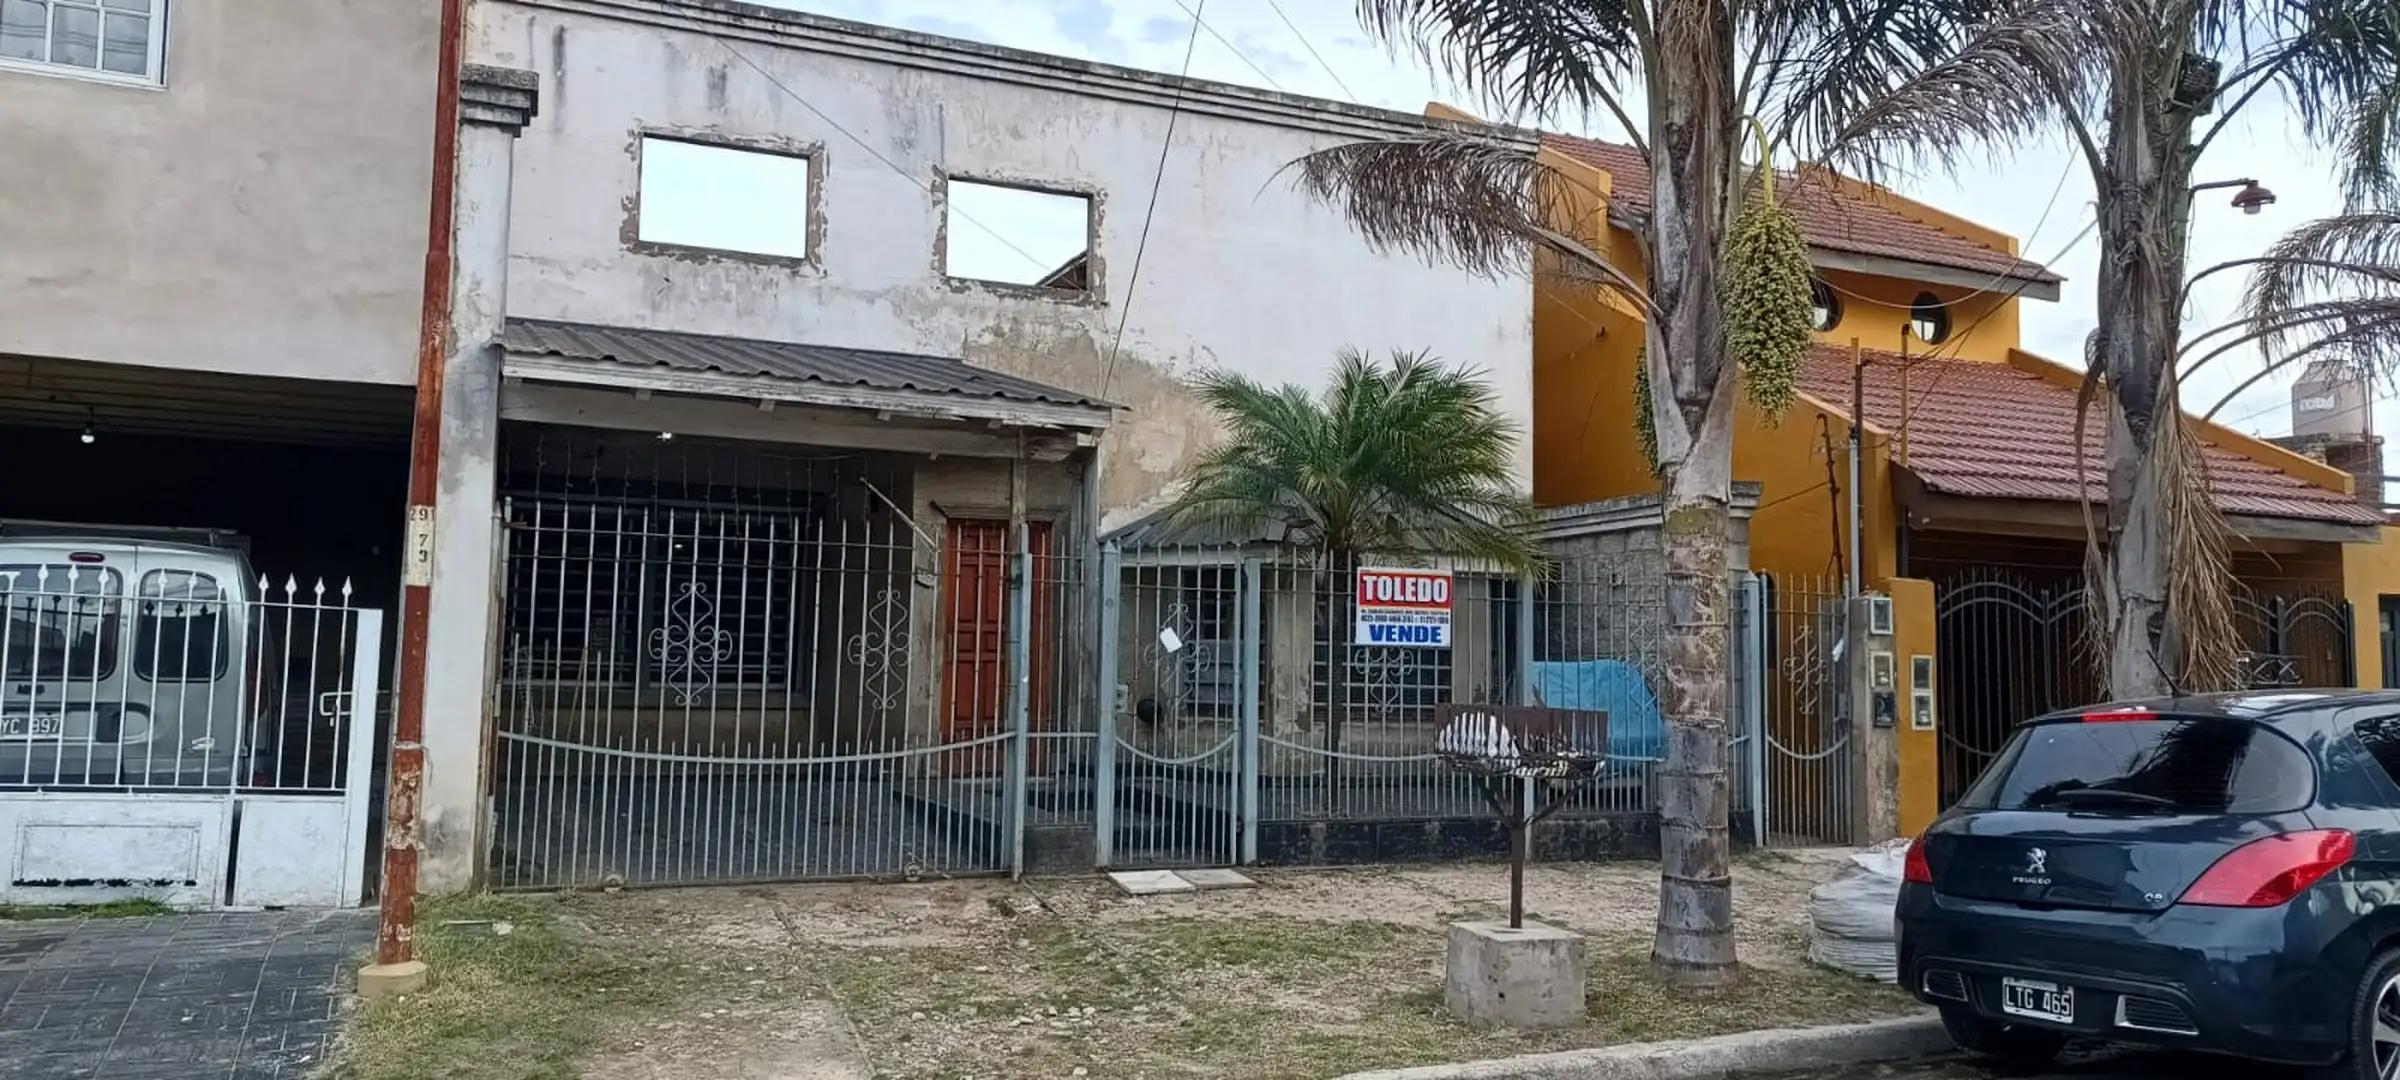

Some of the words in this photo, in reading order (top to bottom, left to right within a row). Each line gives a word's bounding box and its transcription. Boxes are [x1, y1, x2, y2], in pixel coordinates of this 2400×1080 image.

[1362, 575, 1449, 603] TOLEDO
[1369, 624, 1442, 643] VENDE
[2012, 876, 2052, 885] PEUGEO
[2005, 986, 2034, 1009] LTG
[2042, 991, 2070, 1015] 465
